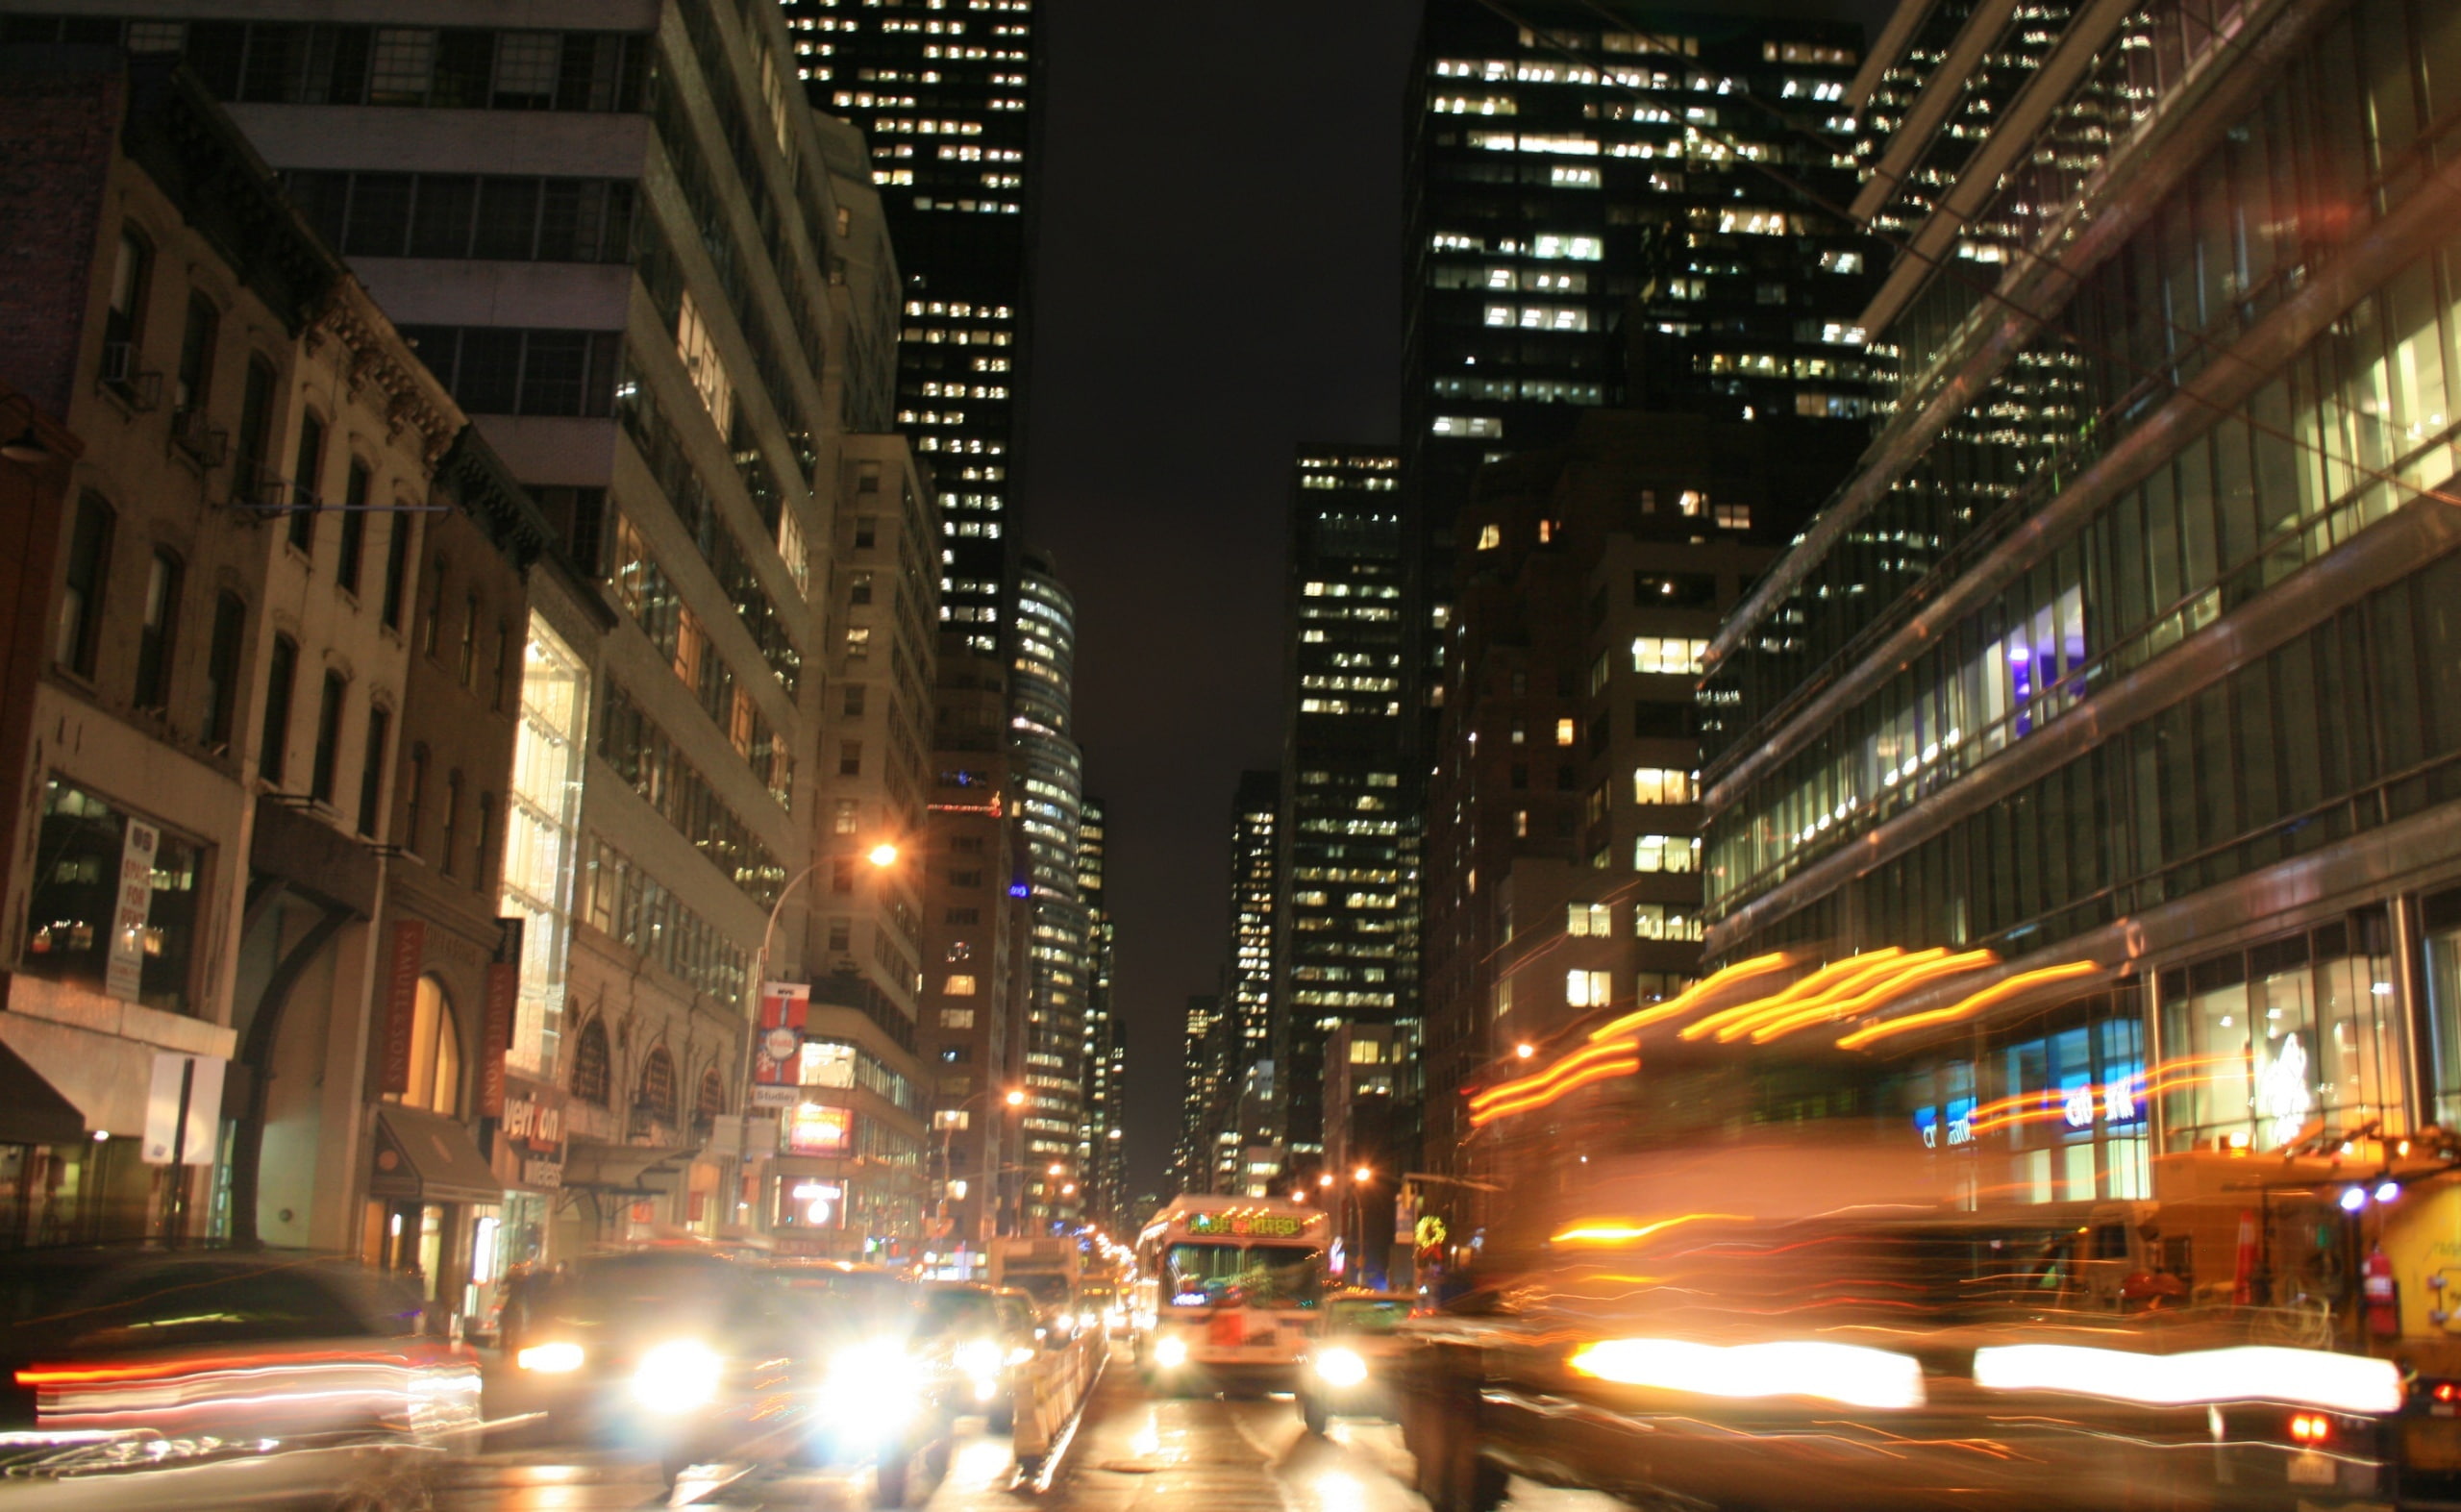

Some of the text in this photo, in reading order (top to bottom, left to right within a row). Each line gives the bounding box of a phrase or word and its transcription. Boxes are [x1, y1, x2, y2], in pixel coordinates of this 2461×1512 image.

[126, 884, 145, 907] FOR
[395, 930, 416, 1008] SAMUEL
[490, 973, 507, 1042] SAMUEL
[388, 1028, 404, 1083] SONS
[484, 1058, 499, 1107] SONS
[503, 1091, 559, 1142] verizon
